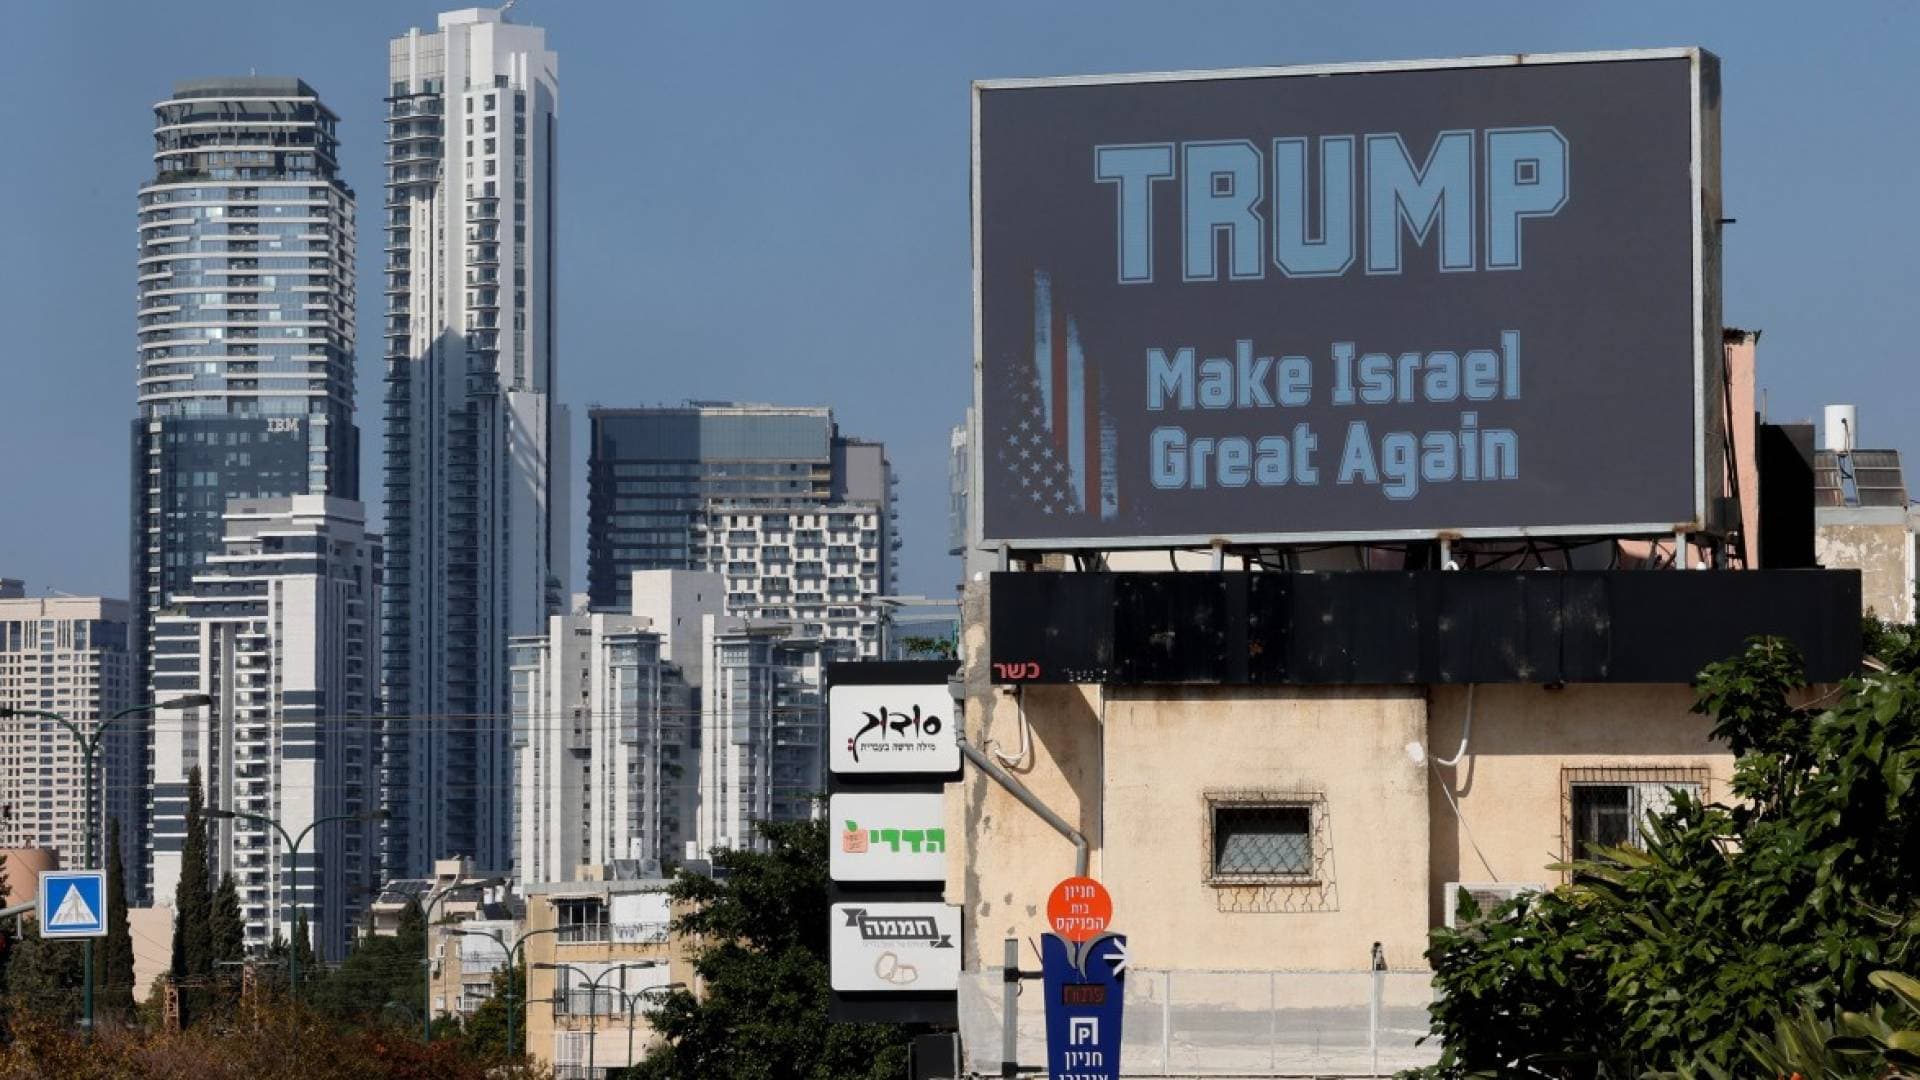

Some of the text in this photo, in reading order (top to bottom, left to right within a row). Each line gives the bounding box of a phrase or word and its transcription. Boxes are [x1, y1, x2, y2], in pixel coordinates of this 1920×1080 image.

[1094, 126, 1570, 283] TRUMP
[1146, 331, 1521, 411] Make Israel
[268, 417, 300, 432] IBM
[1151, 411, 1519, 500] Great Again
[993, 662, 1040, 679] כשר
[1064, 886, 1096, 901] חניון
[1071, 904, 1089, 914] בית
[864, 920, 933, 936] חממה
[1056, 917, 1104, 934] הפניקס
[1065, 1051, 1103, 1071] חניון
